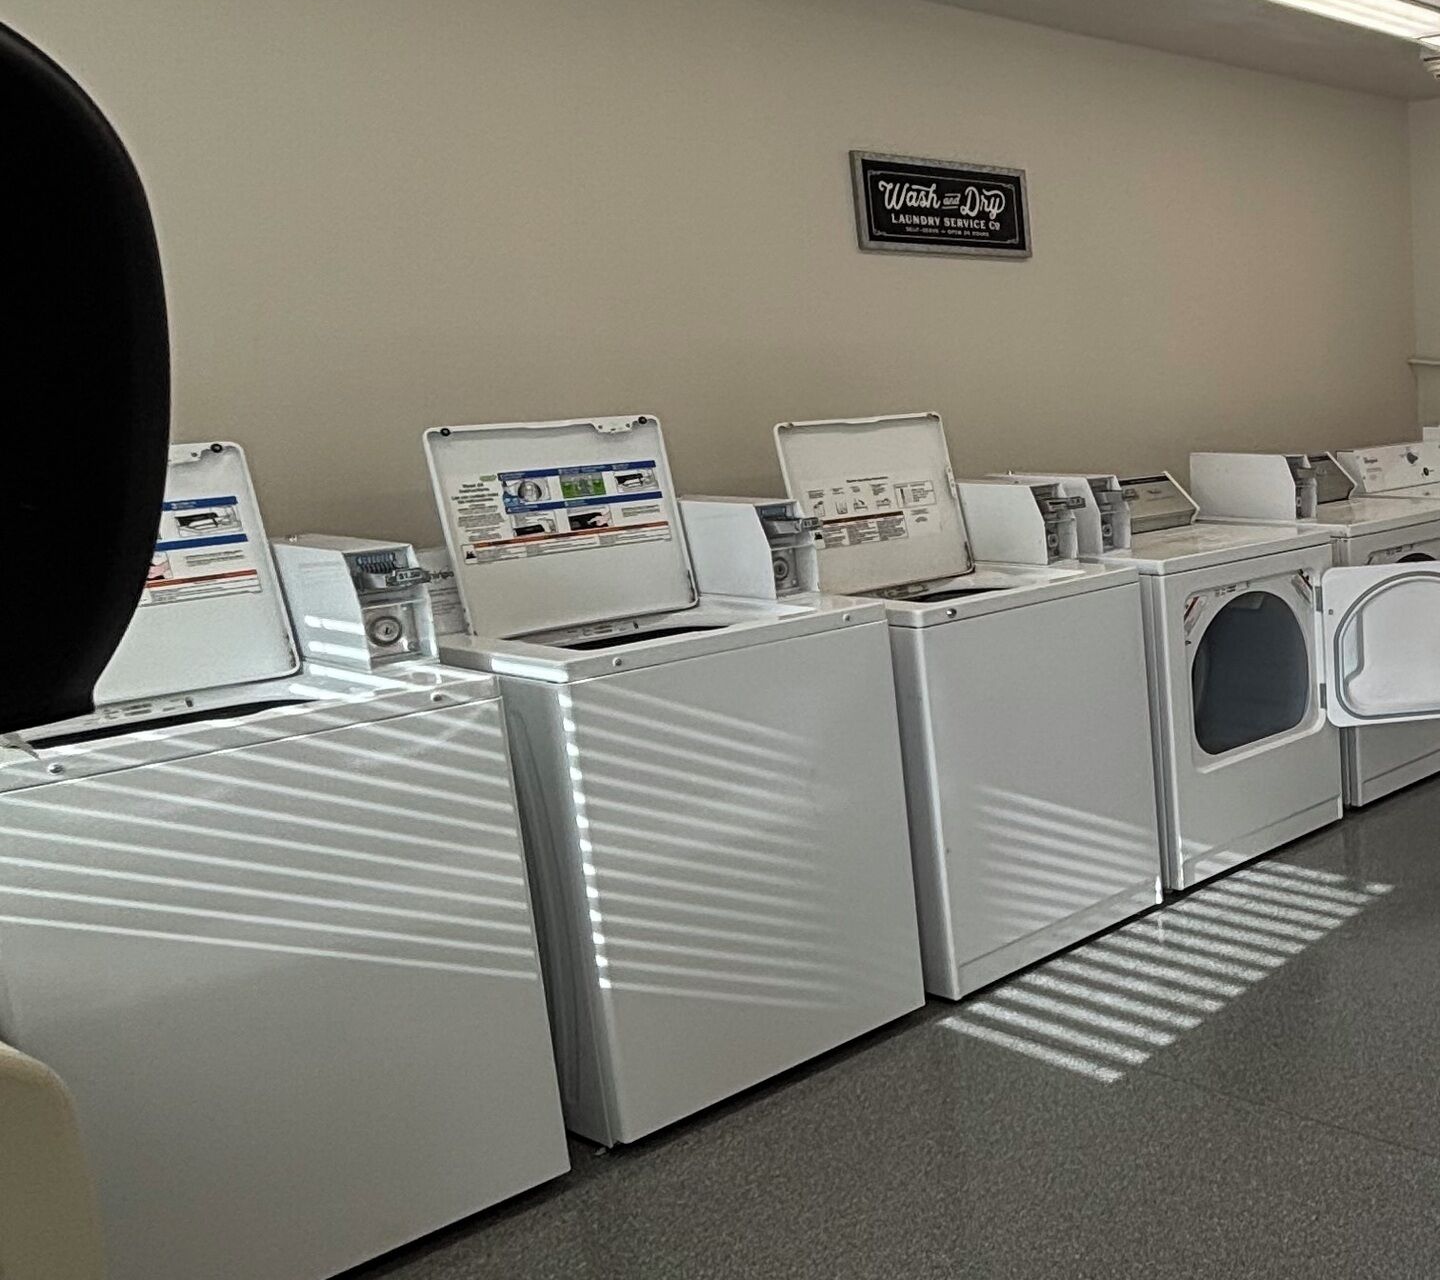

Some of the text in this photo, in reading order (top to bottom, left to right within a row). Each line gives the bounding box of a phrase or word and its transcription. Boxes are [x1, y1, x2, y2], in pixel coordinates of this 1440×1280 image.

[878, 180, 1006, 220] Wash and Dry
[891, 213, 940, 226] LAUNDRY
[943, 217, 986, 230] SERVICE
